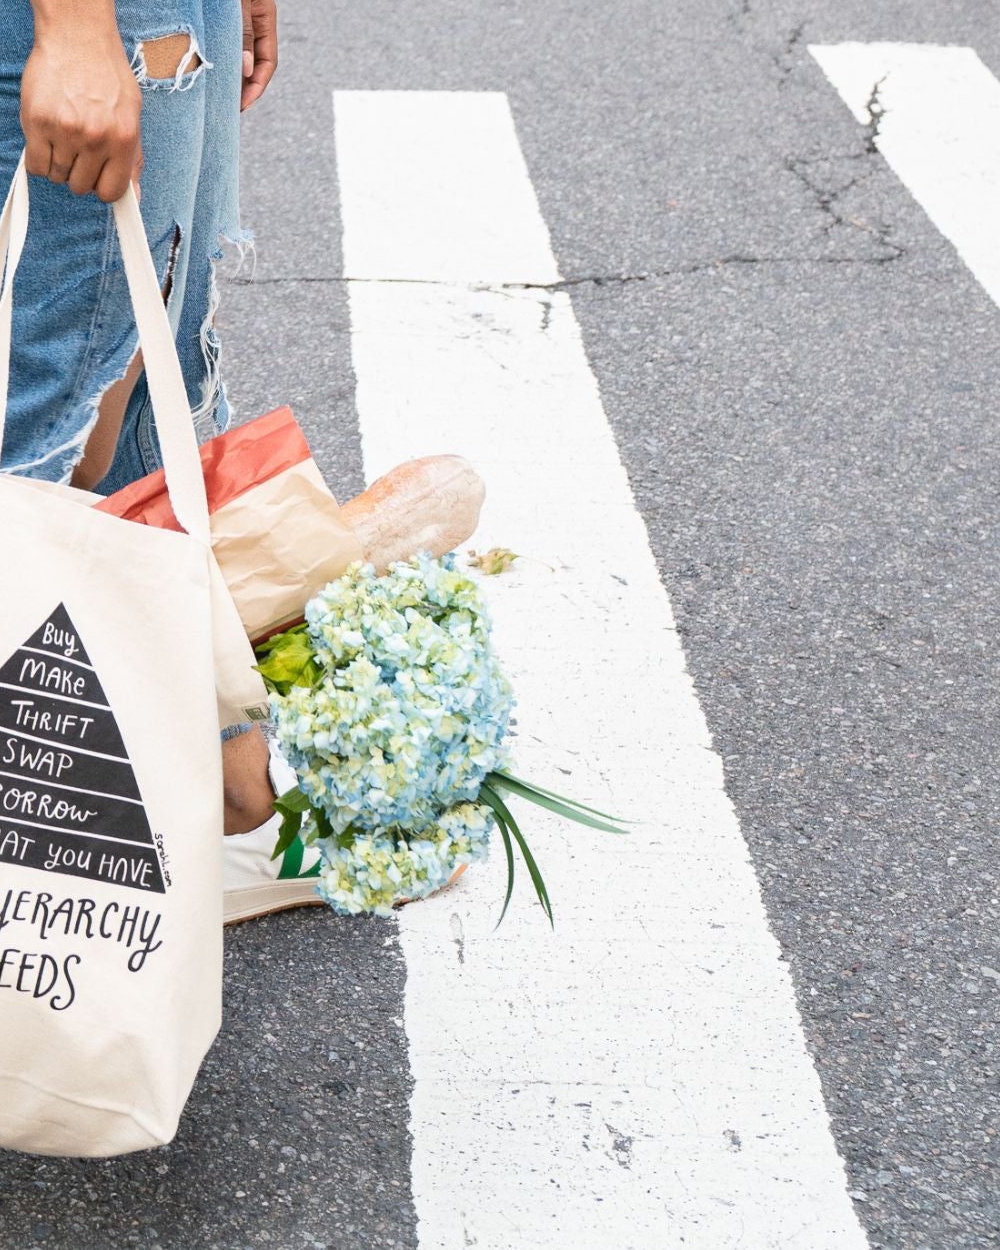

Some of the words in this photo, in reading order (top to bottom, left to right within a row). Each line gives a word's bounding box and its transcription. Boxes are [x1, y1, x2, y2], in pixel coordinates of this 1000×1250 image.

[11, 700, 94, 738] THRIFT
[3, 738, 73, 777] SWAP
[98, 853, 153, 888] HAVE
